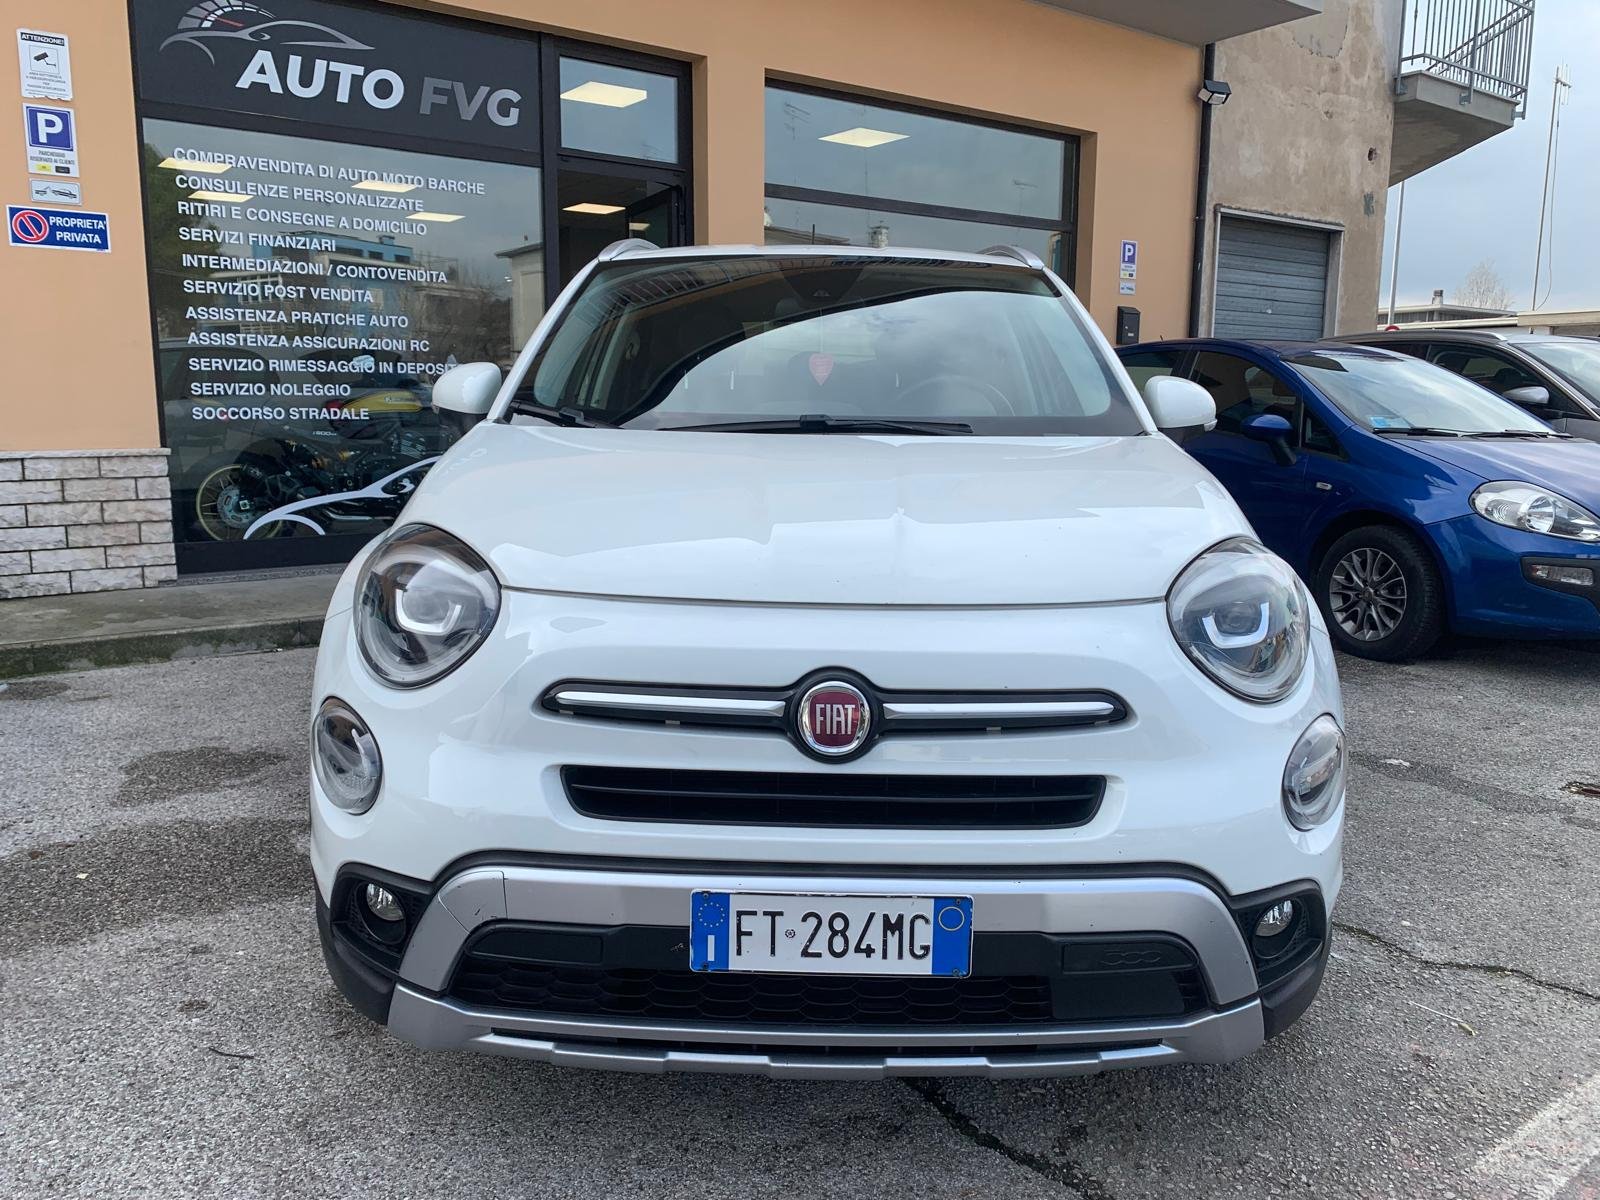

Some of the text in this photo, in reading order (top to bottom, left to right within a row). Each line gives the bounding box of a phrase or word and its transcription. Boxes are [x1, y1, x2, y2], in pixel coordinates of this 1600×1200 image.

[21, 33, 64, 45] ATTENZIONE!
[235, 49, 522, 127] AUTO FVG
[37, 112, 63, 143] P
[173, 148, 485, 194] COMPRAVENDITA DI AUTO MOTO BARCHE
[175, 175, 424, 211] CONSULENZE PERSONALIZZATE
[49, 216, 106, 230] PROPRIETA'
[177, 201, 427, 235] RITIRI E CONSEGNE A DOMICILIO
[56, 231, 102, 244] PRIVATA
[178, 227, 336, 251] SERVIZI FINANZIARI
[1124, 244, 1134, 261] P
[182, 253, 448, 283] INTERMEDIAZIONI / CONTOVENDITA
[183, 279, 374, 302] SERVIZIO POST VENDITA
[185, 306, 408, 328] ASSISTENZA PRATICHE AUTO
[187, 332, 430, 352] ASSISTENZA ASSICURAZIONI RC
[188, 358, 264, 372] SERVIZIO
[269, 359, 375, 373] RIMESSAGGIO
[379, 361, 393, 374] IN
[190, 382, 351, 396] SERVIZIO NOLEGGIO
[192, 407, 370, 420] SOCCORSO STRADALE
[815, 703, 856, 735] FIAT
